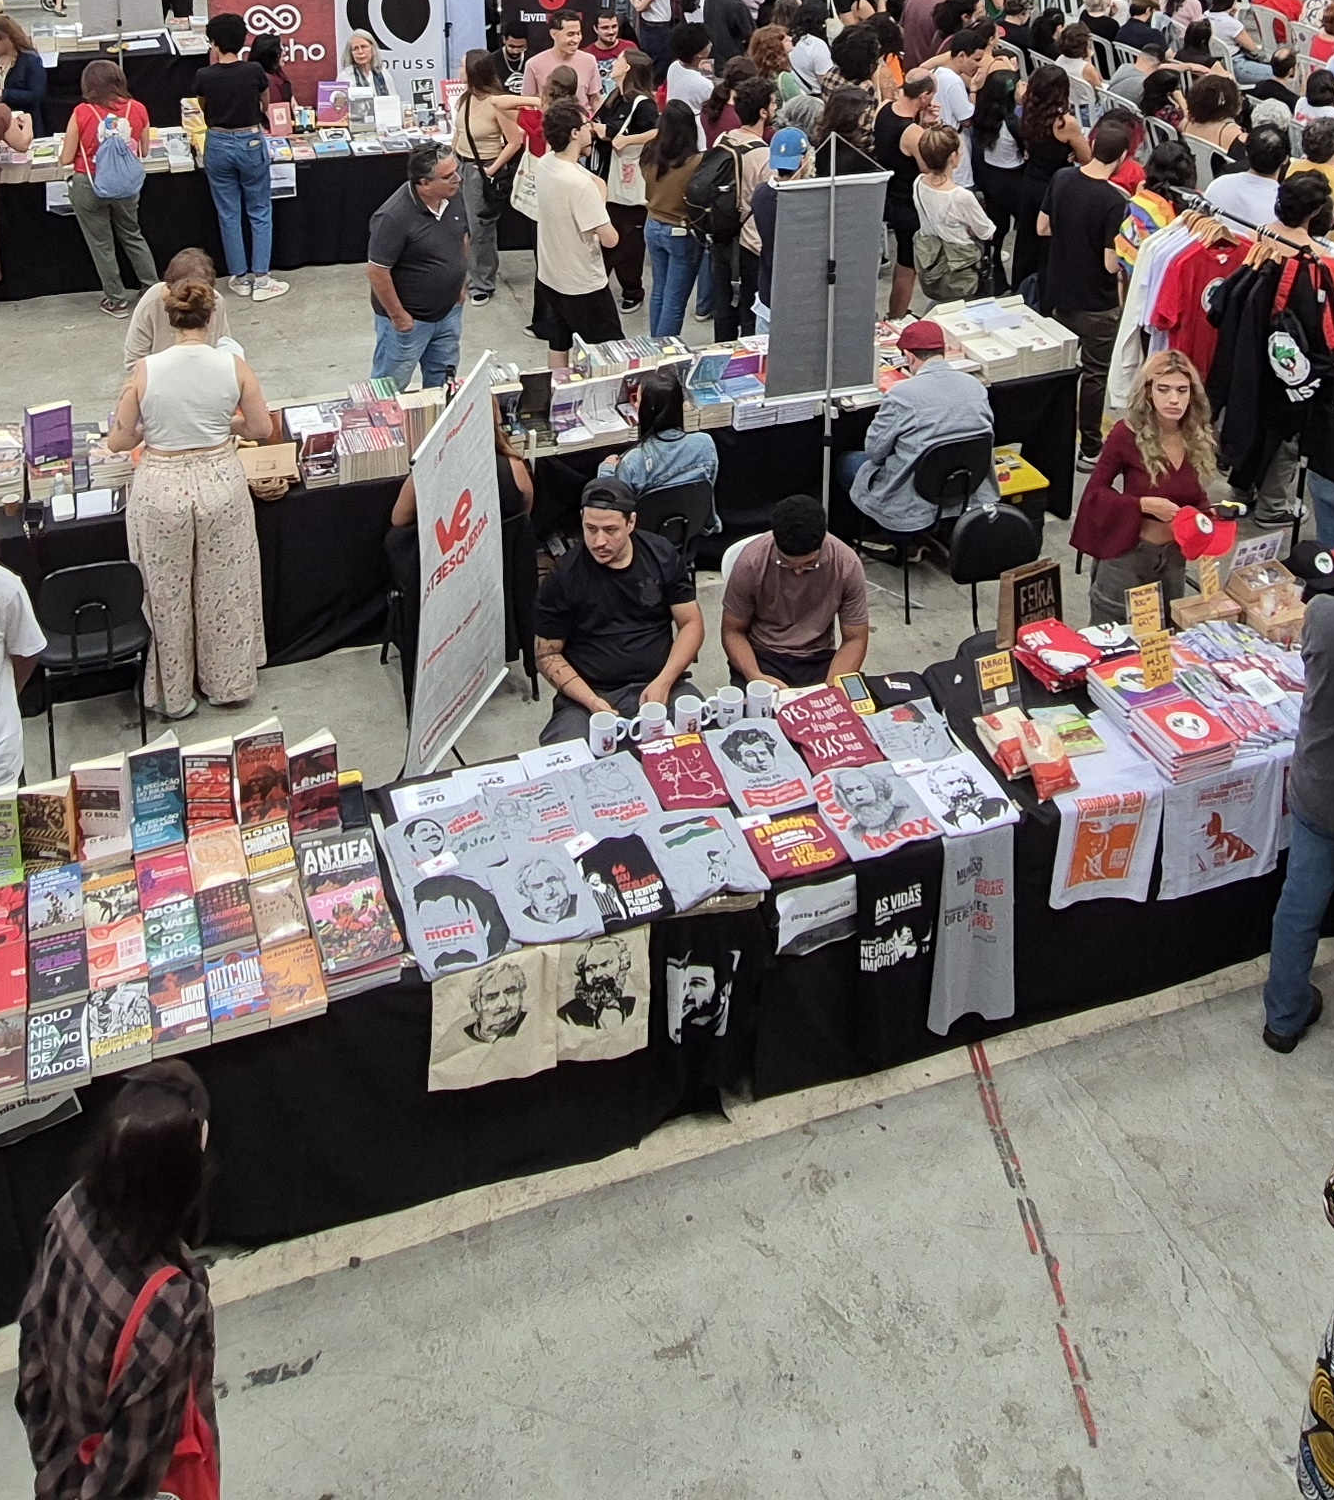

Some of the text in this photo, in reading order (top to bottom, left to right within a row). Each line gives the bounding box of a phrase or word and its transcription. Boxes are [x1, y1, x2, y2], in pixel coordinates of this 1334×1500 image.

[1020, 577, 1055, 615] FEIRA
[1147, 655, 1168, 668] MST
[754, 816, 818, 839] a história
[861, 816, 939, 851] MARX
[303, 838, 374, 874] ANTIFA
[317, 884, 377, 911] JACOBIN
[875, 888, 922, 917] AS VIDAS
[148, 915, 195, 935] O VALE
[161, 933, 185, 947] DO
[207, 957, 261, 992] BITCOIN
[30, 1008, 72, 1027] COLO
[30, 1031, 80, 1053] LISMO
[31, 1026, 61, 1040] NIA
[30, 1051, 53, 1067] DE
[30, 1056, 88, 1081] DADOS
